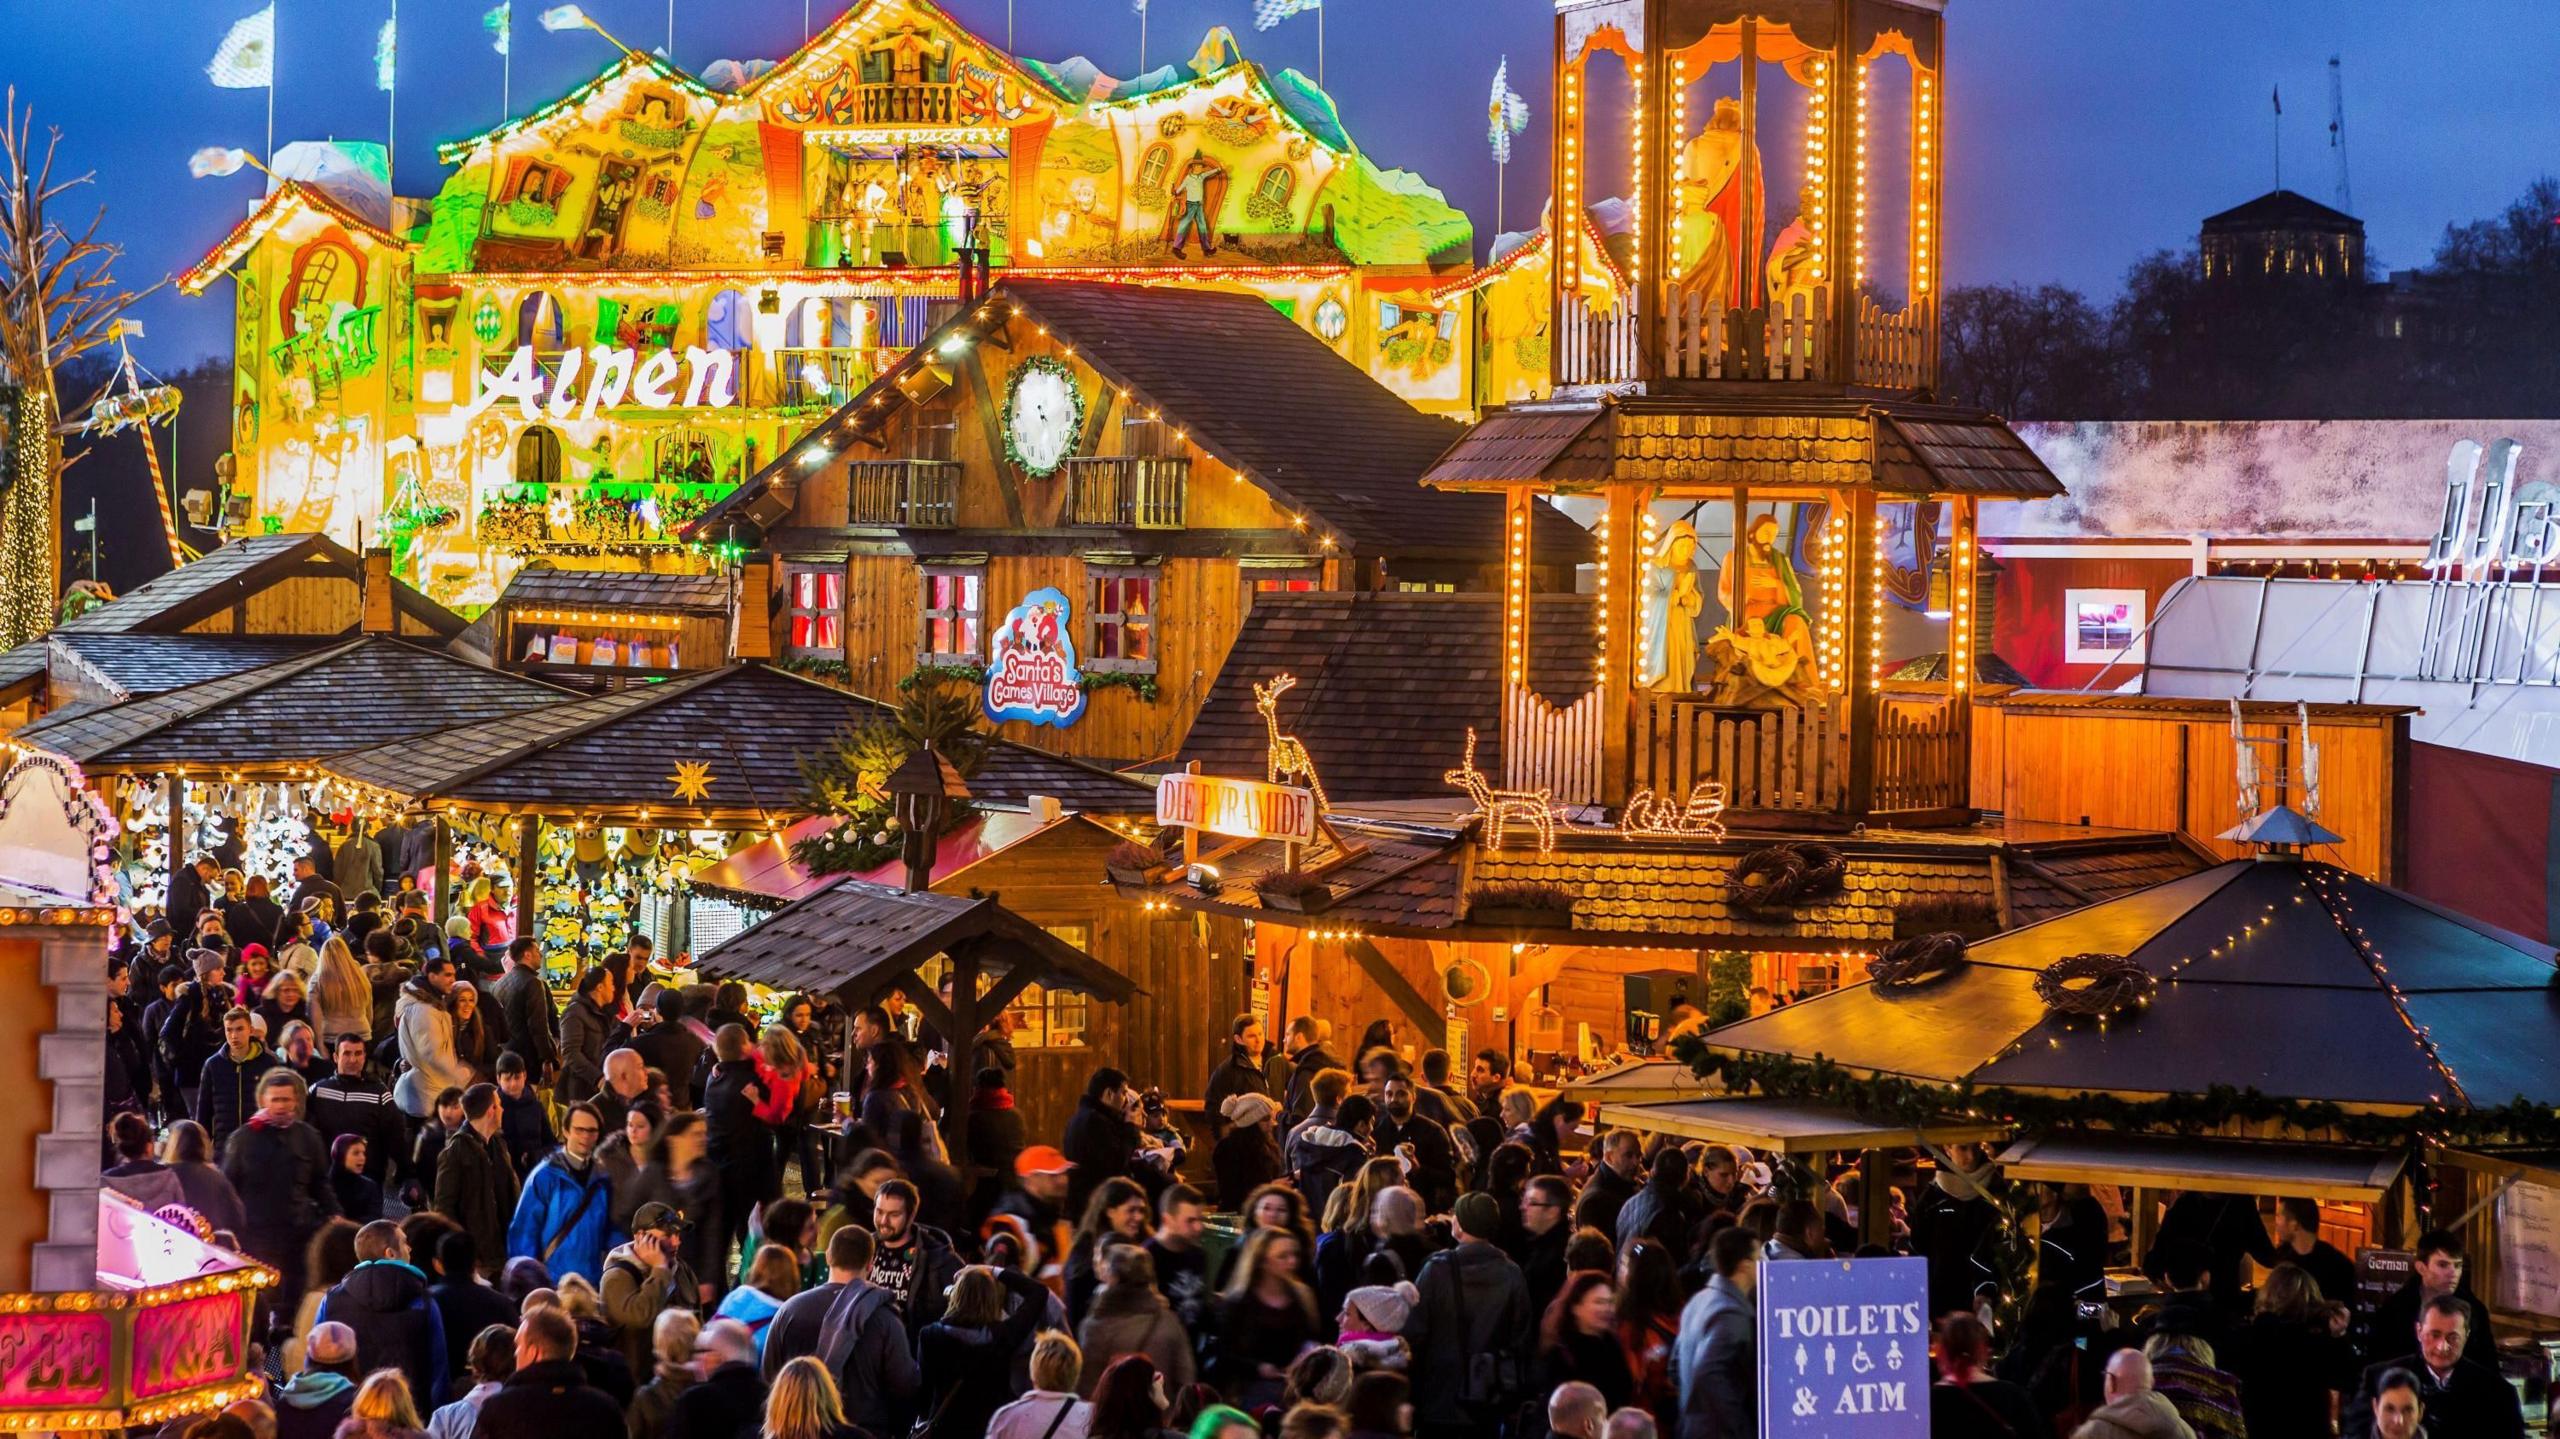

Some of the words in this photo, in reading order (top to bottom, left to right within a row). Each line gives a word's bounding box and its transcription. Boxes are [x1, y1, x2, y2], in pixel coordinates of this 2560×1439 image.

[478, 345, 738, 423] Alpen
[1005, 657, 1061, 684] Santa's
[993, 681, 1033, 704] Games
[1033, 682, 1075, 709] Village
[1162, 779, 1195, 823] DIE
[1200, 783, 1308, 838] PYRAMIDE
[870, 1264, 905, 1288] Merry
[2368, 1255, 2409, 1272] German
[1774, 1300, 1921, 1338] TOILETS
[1791, 1385, 1819, 1417] &
[1833, 1381, 1907, 1415] ATM
